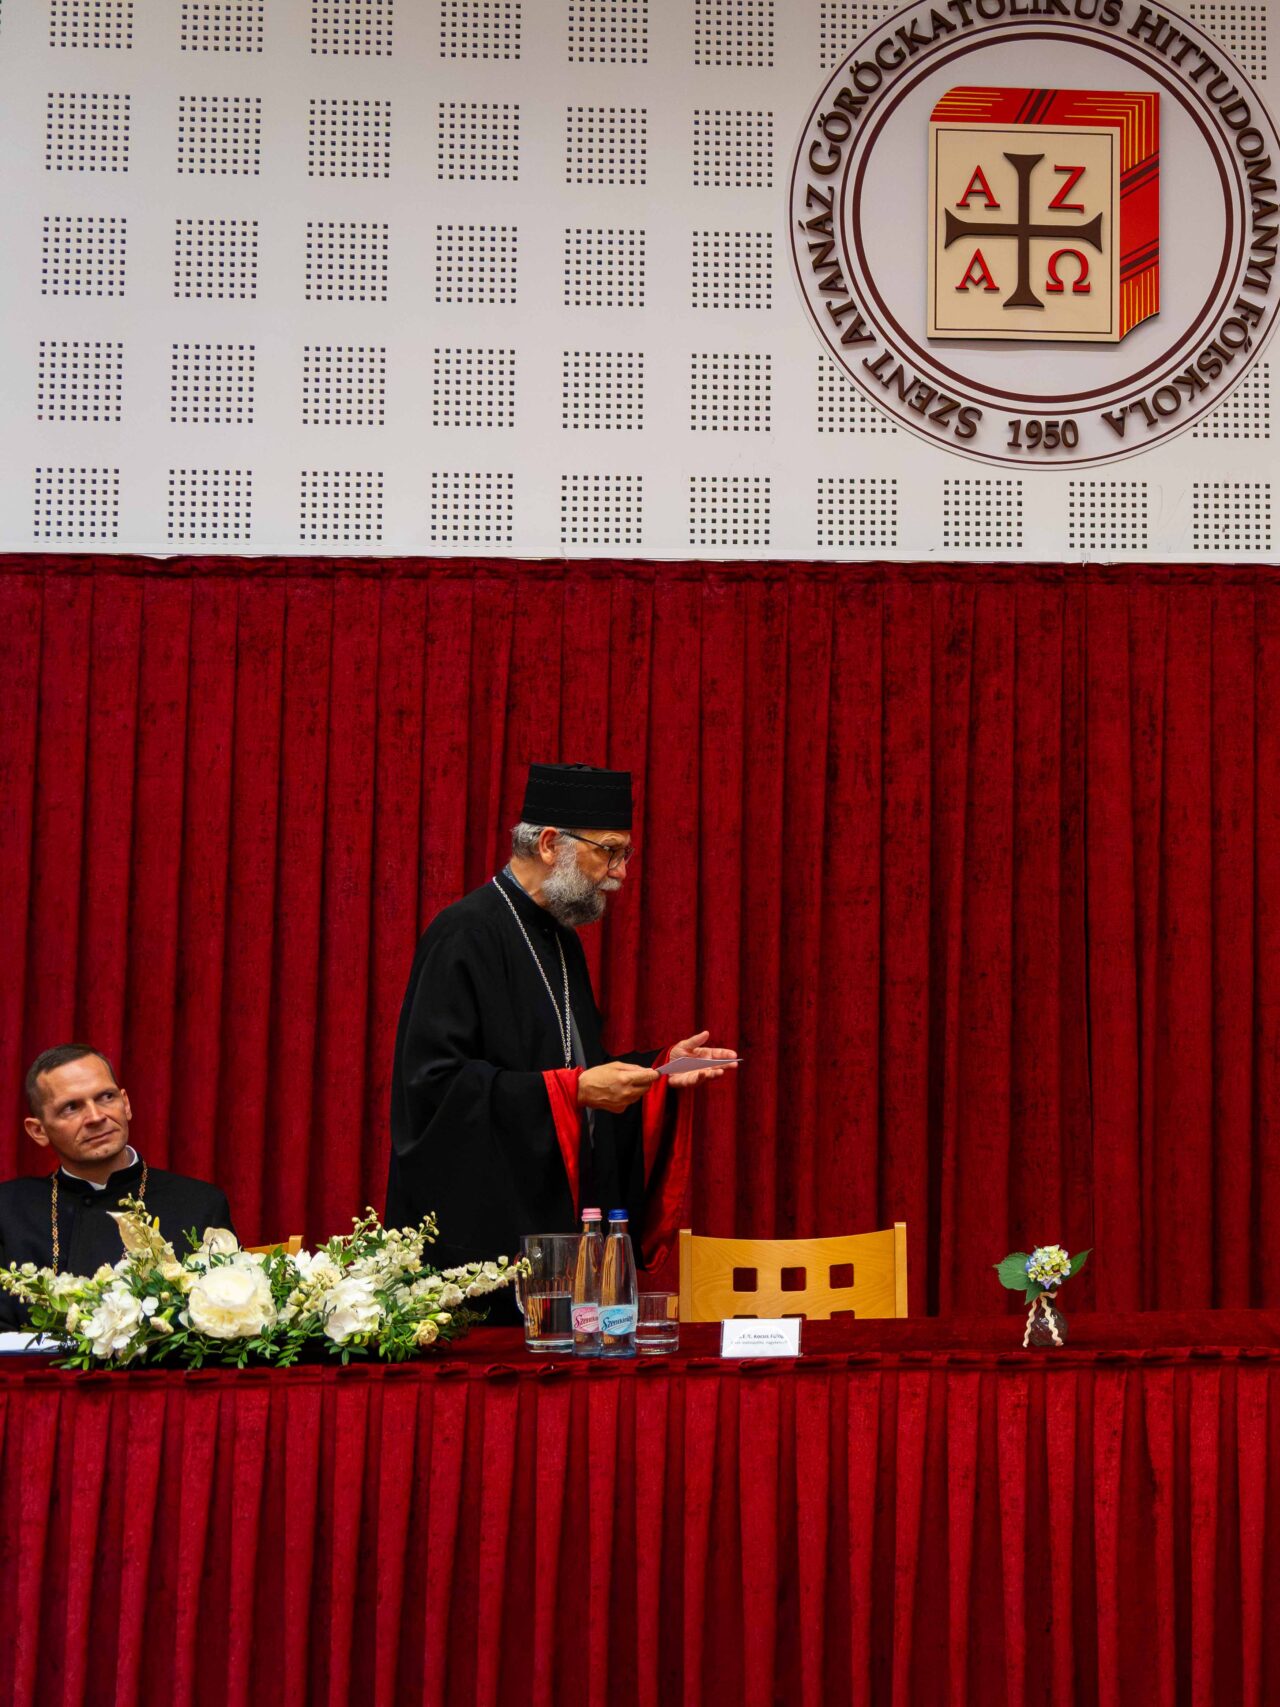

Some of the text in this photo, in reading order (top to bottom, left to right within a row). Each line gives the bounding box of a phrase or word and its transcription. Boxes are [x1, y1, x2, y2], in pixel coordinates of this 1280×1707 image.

[956, 164, 1086, 213] A Z
[798, 184, 877, 345] ATANÁZ
[1046, 248, 1091, 292] Ω
[862, 349, 983, 438] SZENT
[1101, 295, 1266, 437] FŐISKOLA
[1007, 419, 1079, 449] 1950
